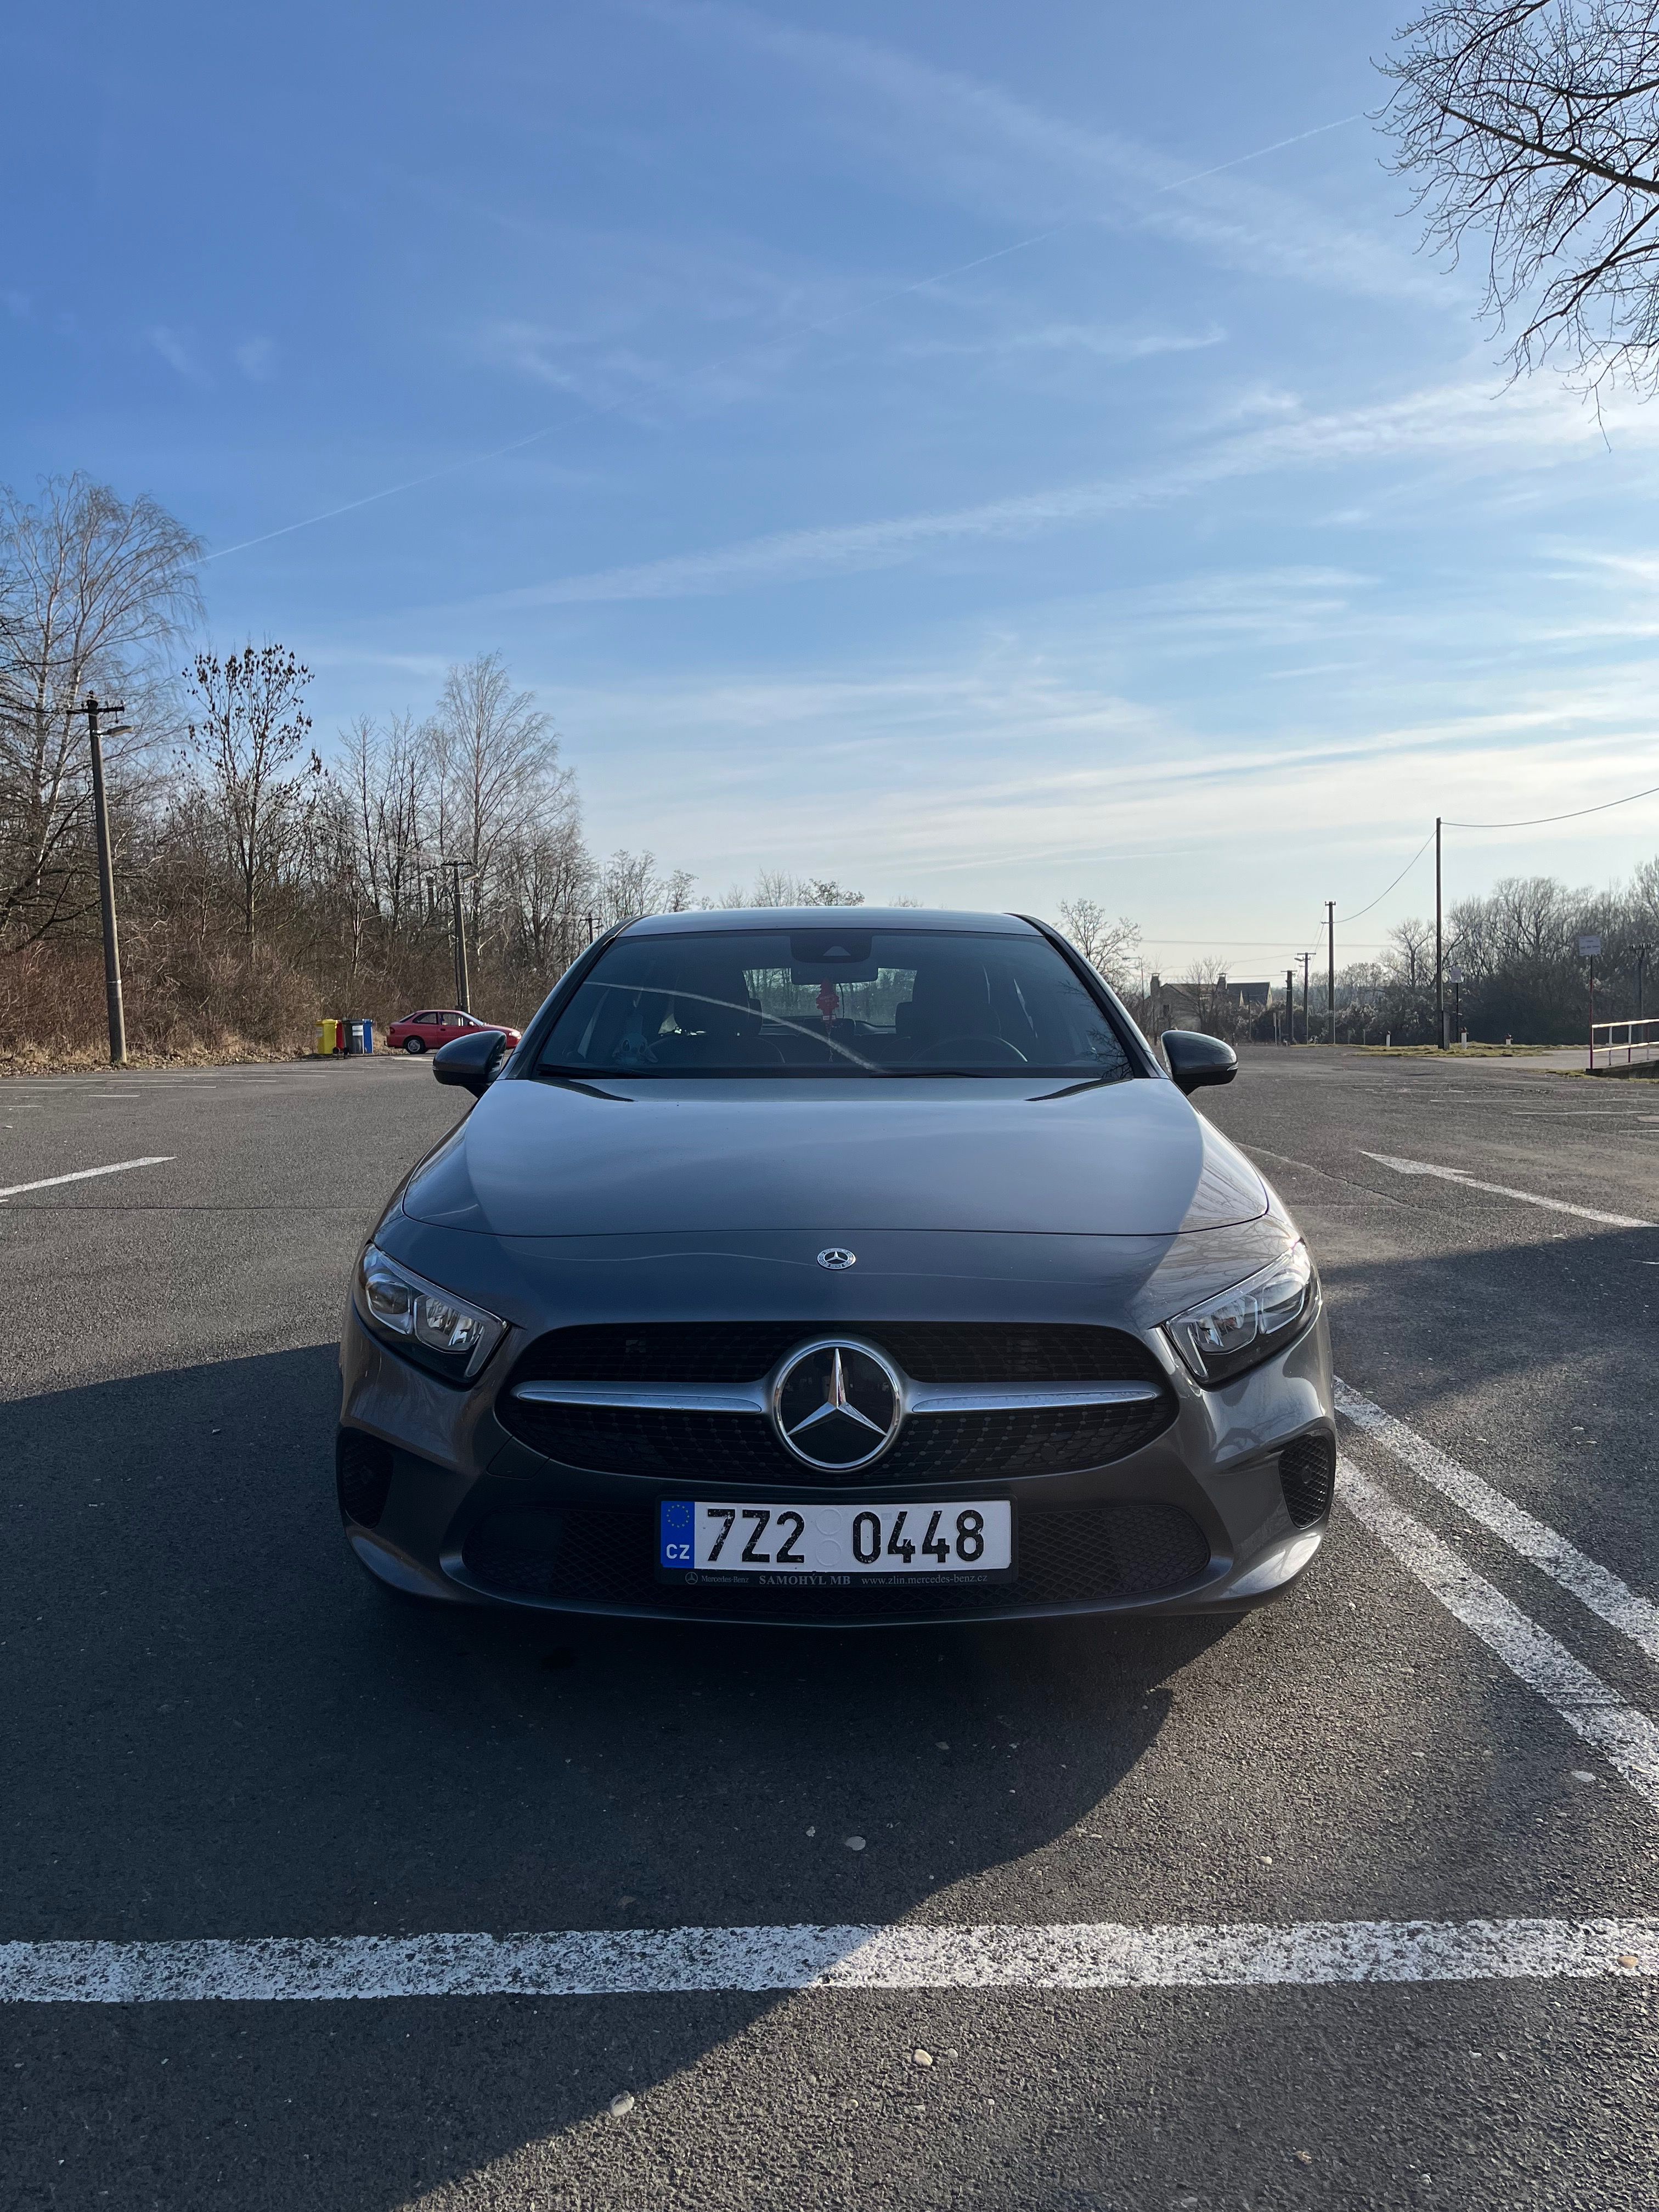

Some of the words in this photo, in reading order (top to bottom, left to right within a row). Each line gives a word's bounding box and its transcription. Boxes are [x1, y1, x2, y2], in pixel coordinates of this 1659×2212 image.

[707, 1508, 805, 1564] 7Z2
[853, 1509, 984, 1564] 0448
[665, 1543, 690, 1560] CZ
[701, 1575, 749, 1583] Mercedes-Benz
[759, 1573, 826, 1585] SAMOHÝL
[830, 1575, 851, 1585] MB
[861, 1574, 988, 1585] www.zlin.mercedes-benz.cz
